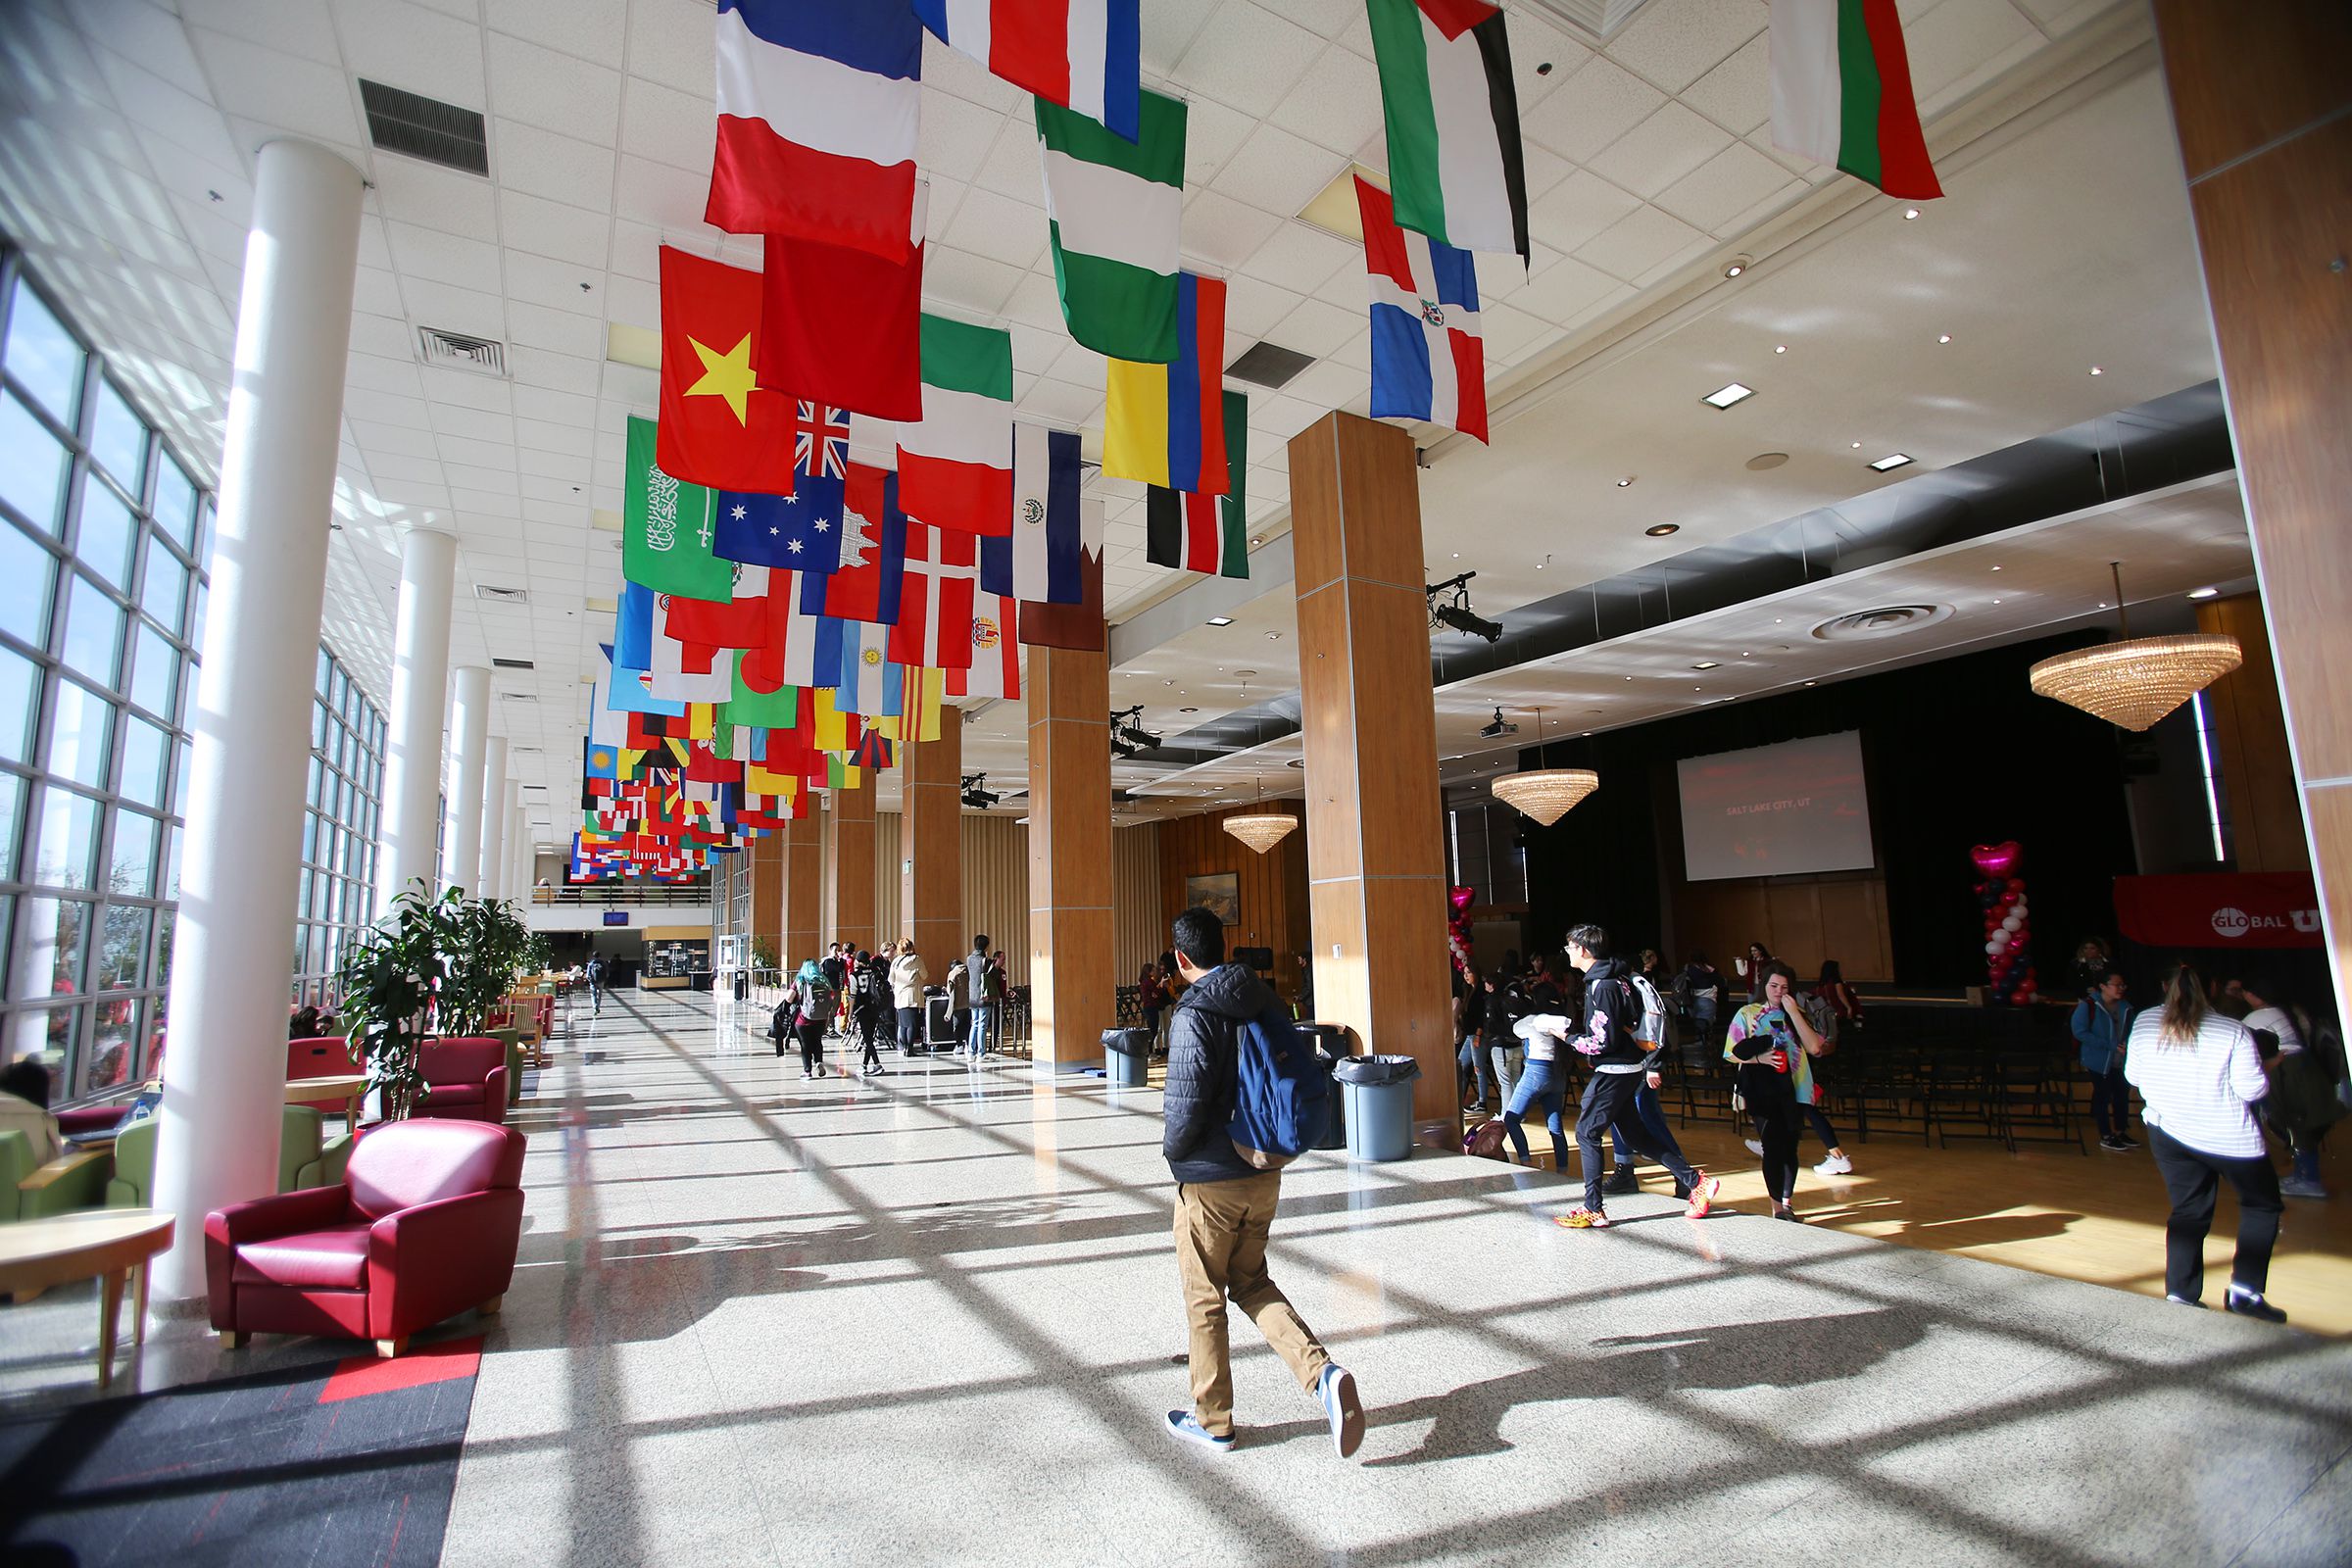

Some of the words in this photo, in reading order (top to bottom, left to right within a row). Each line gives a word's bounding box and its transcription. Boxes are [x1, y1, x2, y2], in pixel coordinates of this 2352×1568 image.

[1726, 806, 1747, 815] SALT
[1748, 802, 1772, 812] LAKE
[1797, 798, 1811, 808] UT
[2215, 916, 2286, 928] GLOBAL
[2289, 908, 2323, 933] U
